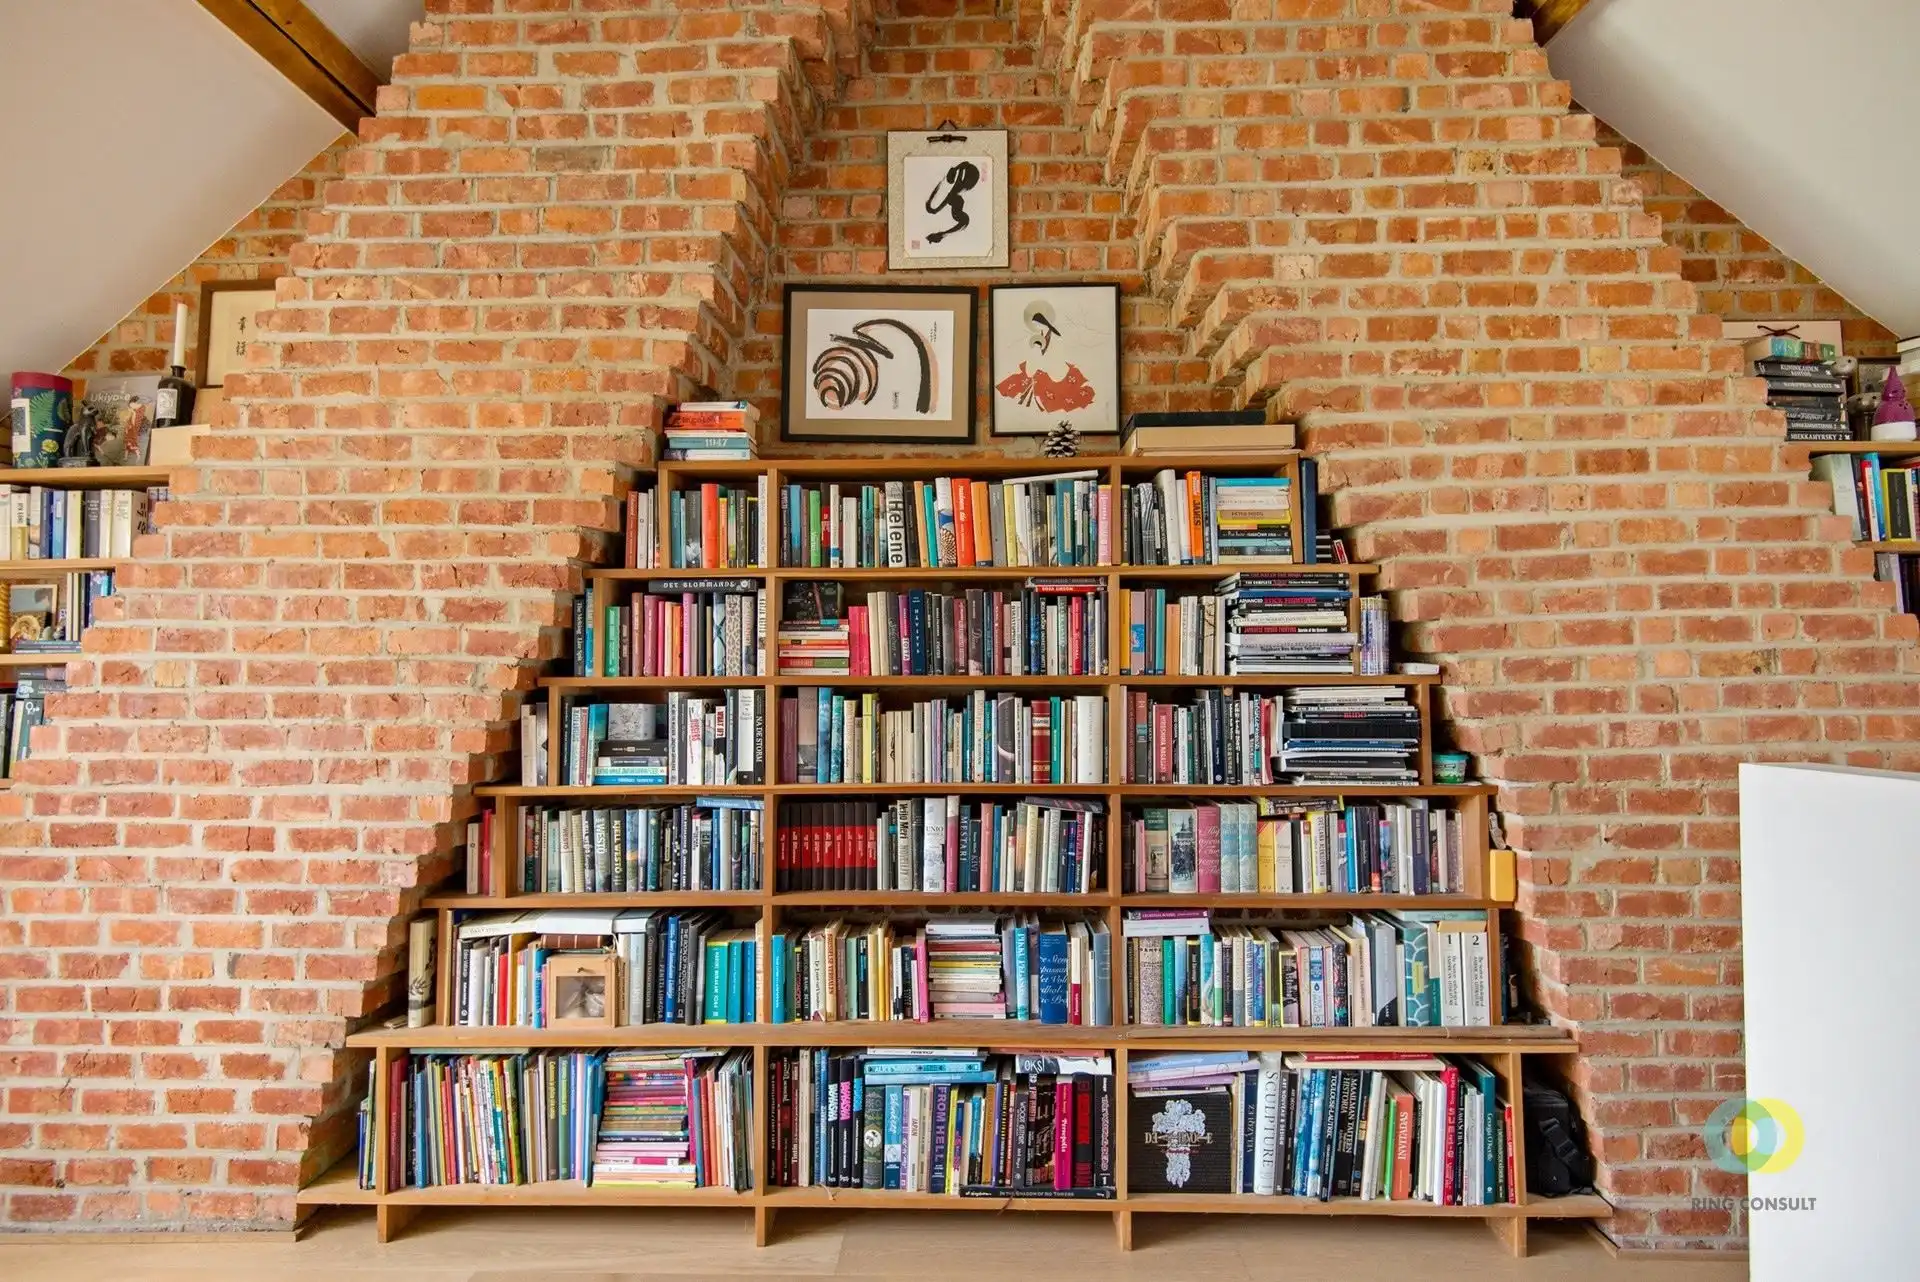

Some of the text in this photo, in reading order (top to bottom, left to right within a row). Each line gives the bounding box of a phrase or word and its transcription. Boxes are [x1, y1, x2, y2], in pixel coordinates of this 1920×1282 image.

[888, 499, 906, 564] Helene
[716, 711, 725, 727] WHAT
[755, 715, 763, 763] NA DE STORM
[595, 823, 608, 854] WESTÖ
[612, 820, 623, 873] KJELL WESTÖ
[900, 831, 910, 849] Meri
[959, 815, 969, 862] MESTARI
[1472, 935, 1480, 946] 2
[1326, 1074, 1338, 1139] TOULOUSE-LAUTREC
[1340, 1077, 1351, 1114] HISTORIA
[1345, 1078, 1358, 1153] MAAILMAN TAITEEN
[911, 1117, 919, 1137] JAPAN
[935, 1086, 948, 1161] FROM HELL
[1060, 1117, 1068, 1153] Persepolis
[1262, 1071, 1279, 1168] SCULPTURE
[1397, 1111, 1409, 1160] INVITADAS
[1485, 1113, 1495, 1161] Georgia O'Keeffe
[791, 1143, 799, 1165] Tintin
